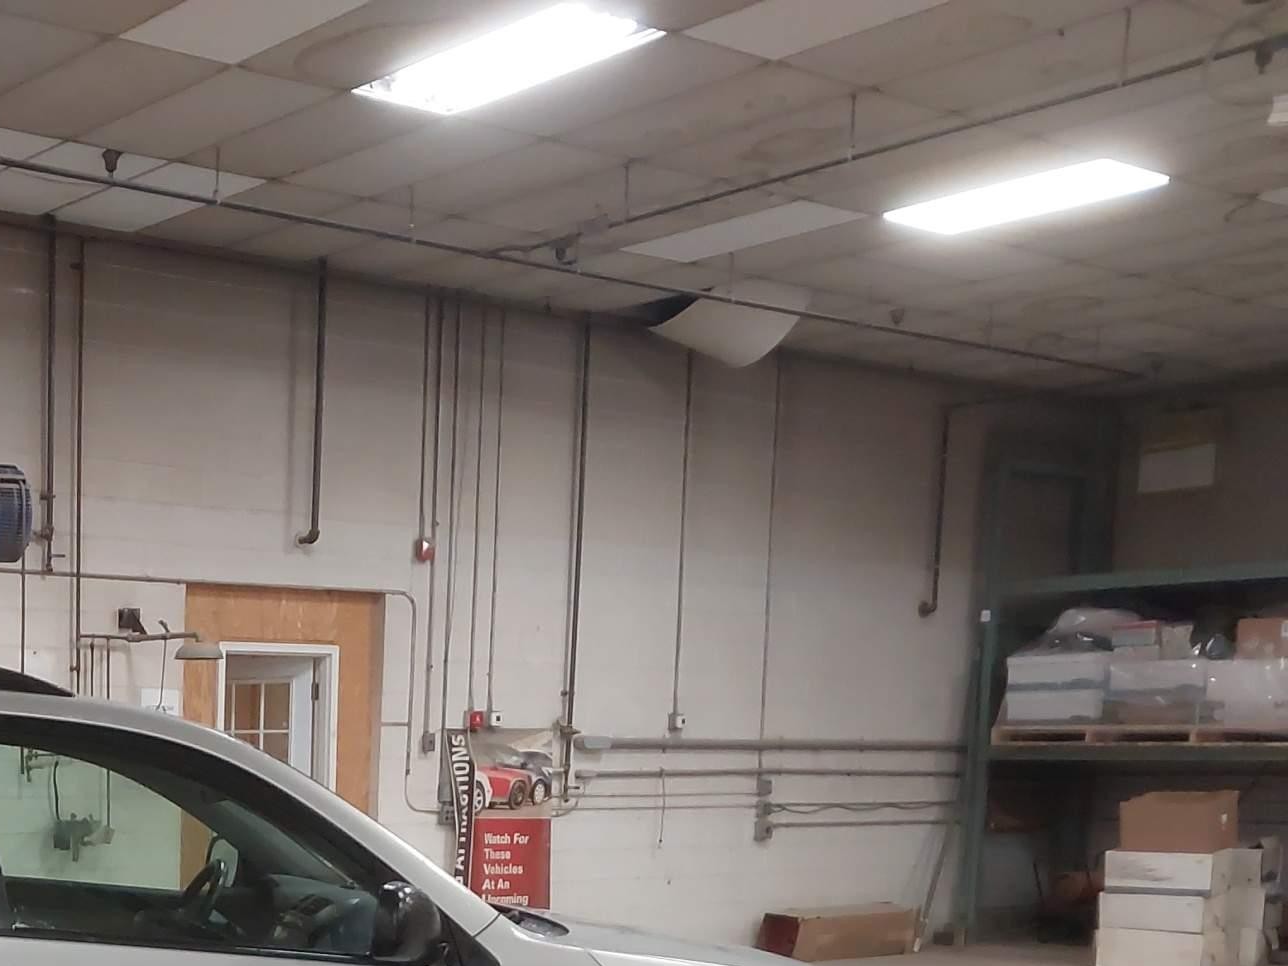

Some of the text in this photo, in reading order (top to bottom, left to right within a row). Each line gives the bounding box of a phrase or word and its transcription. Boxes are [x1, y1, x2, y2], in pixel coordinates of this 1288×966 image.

[484, 833, 529, 844] Watch For
[483, 848, 511, 860] These
[483, 863, 523, 875] Vehicles
[482, 878, 510, 890] At An
